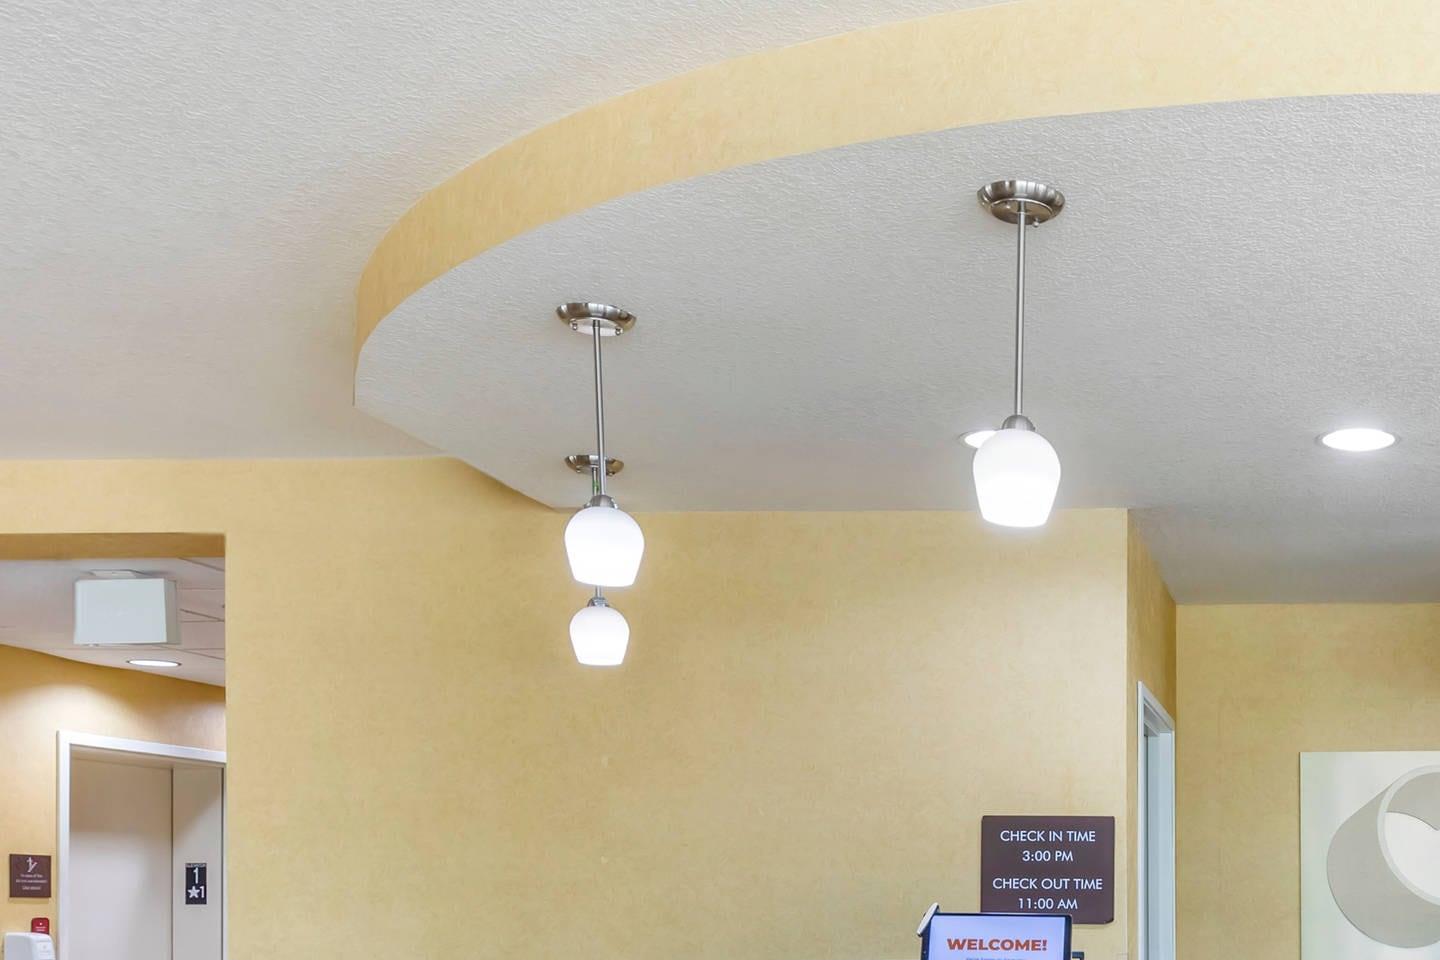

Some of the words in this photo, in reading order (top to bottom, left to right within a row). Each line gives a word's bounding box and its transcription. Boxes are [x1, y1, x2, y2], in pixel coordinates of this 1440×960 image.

[1000, 830, 1045, 842] CHECK
[1049, 830, 1063, 842] IN
[1066, 830, 1096, 842] TIME
[1022, 850, 1051, 862] 3:00
[1055, 851, 1074, 862] PM
[193, 867, 199, 884] 1
[992, 878, 1038, 890] CHECK
[1041, 878, 1070, 890] OUT
[1073, 878, 1103, 890] TIME
[1018, 898, 1054, 910] 11:00
[1057, 898, 1078, 910] AM
[946, 938, 1047, 951] WELCOME!
